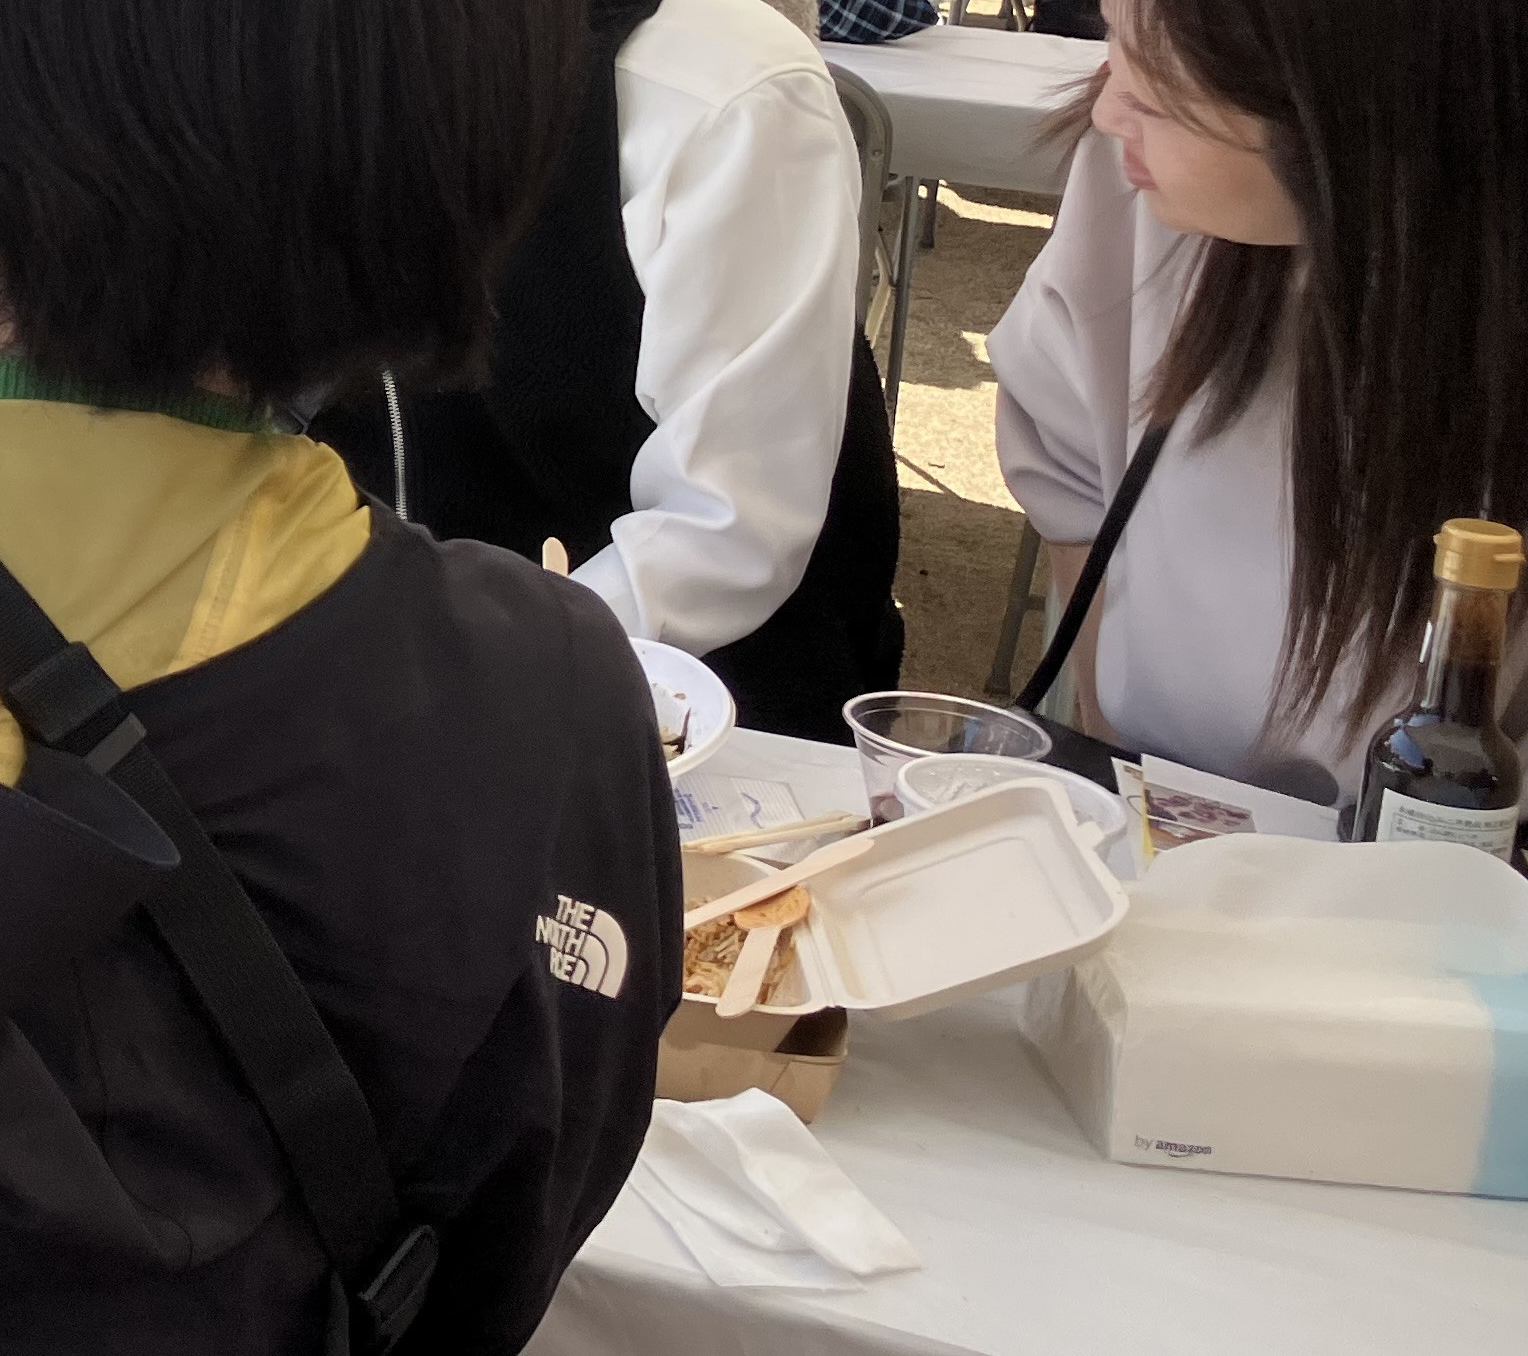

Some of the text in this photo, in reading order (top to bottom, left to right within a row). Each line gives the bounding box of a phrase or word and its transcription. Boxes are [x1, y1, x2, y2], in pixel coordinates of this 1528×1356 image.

[555, 894, 596, 931] THE
[1134, 1135, 1212, 1155] by amazon
